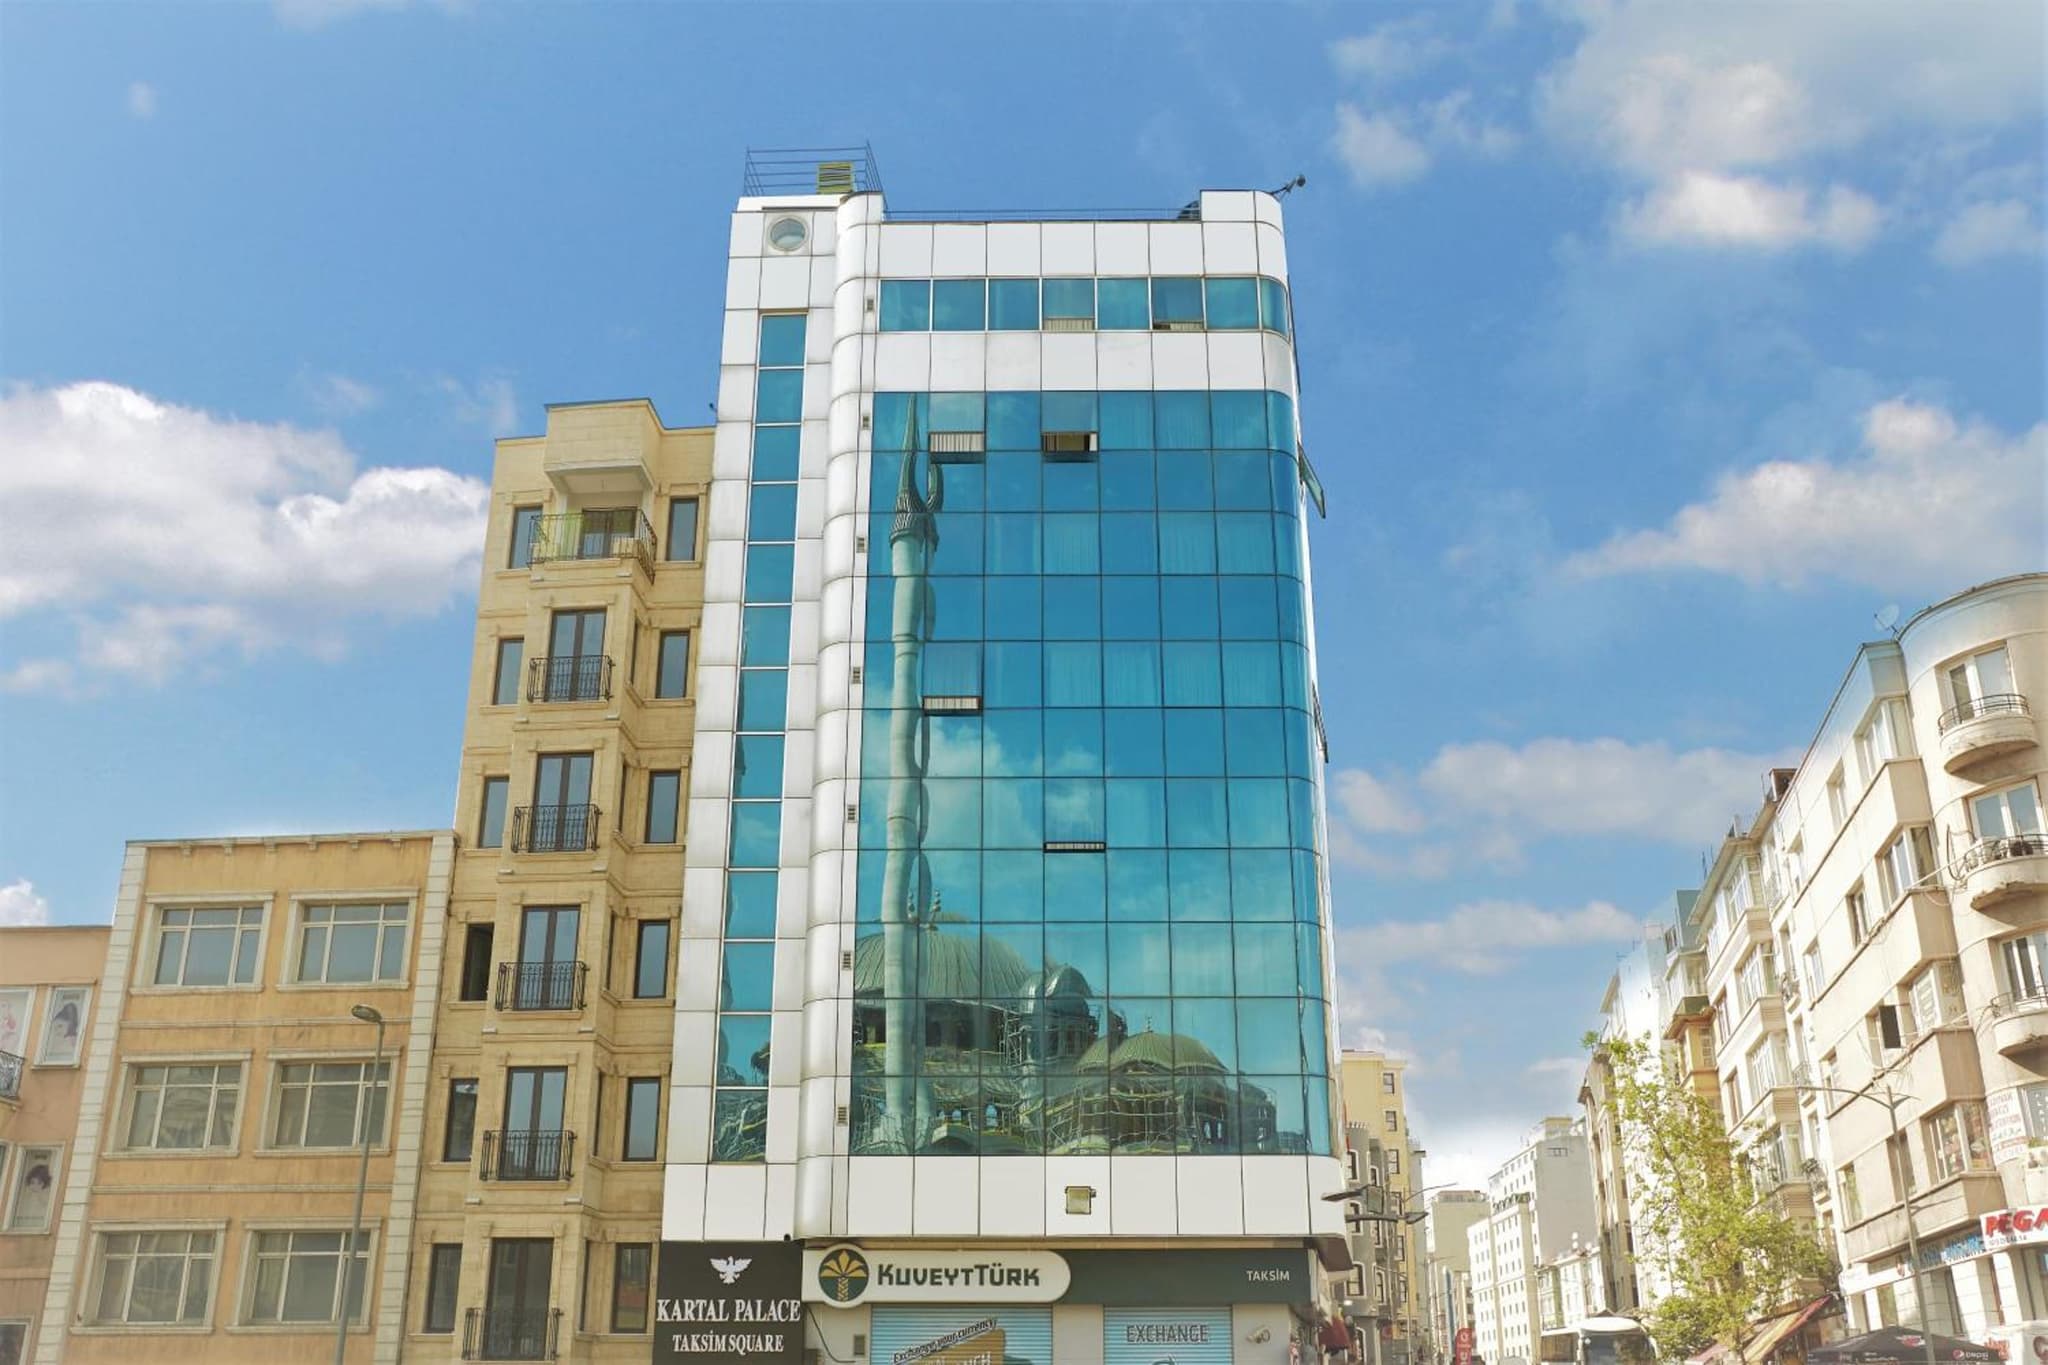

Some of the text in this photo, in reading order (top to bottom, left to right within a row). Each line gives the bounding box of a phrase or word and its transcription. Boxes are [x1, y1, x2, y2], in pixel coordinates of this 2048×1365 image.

[1246, 1268, 1290, 1281] TAKSİM
[656, 1298, 801, 1322] KARTAL PALACE
[672, 1330, 785, 1356] TAKSİM SQUARE
[1126, 1323, 1210, 1344] EXCHANGE
